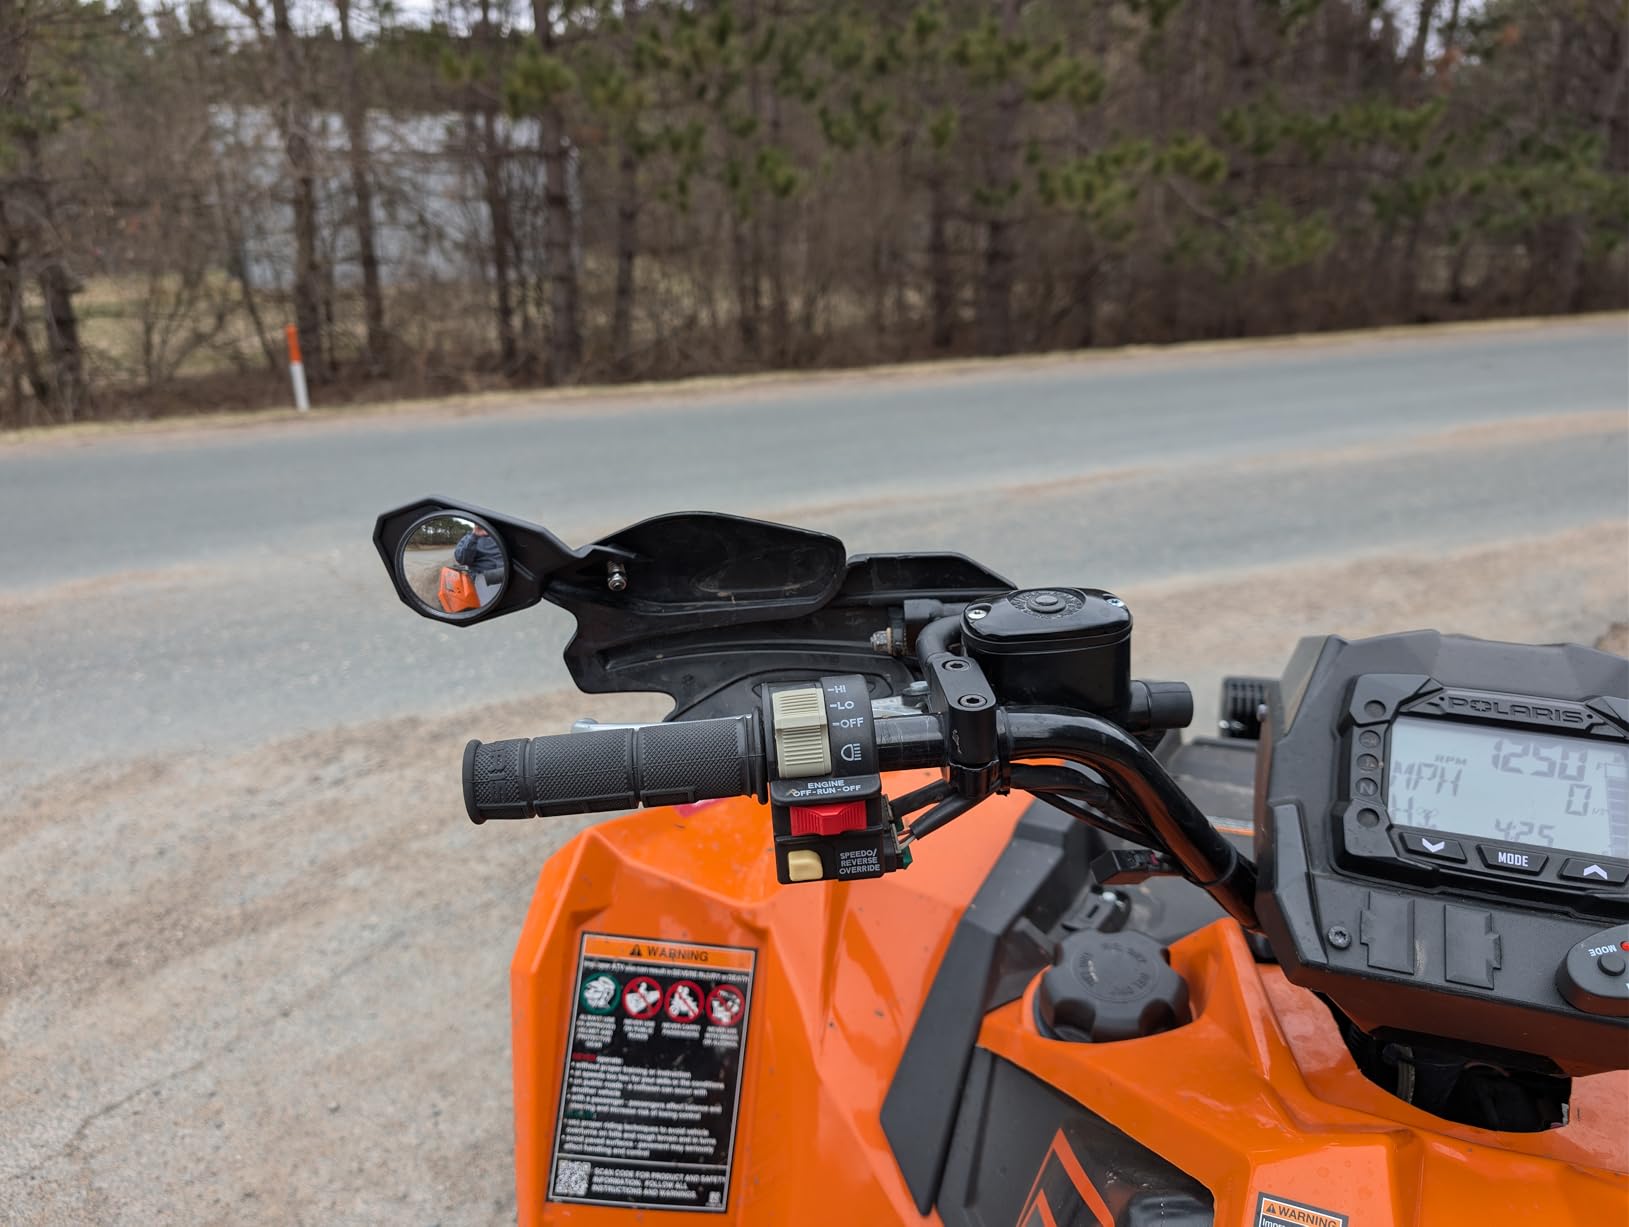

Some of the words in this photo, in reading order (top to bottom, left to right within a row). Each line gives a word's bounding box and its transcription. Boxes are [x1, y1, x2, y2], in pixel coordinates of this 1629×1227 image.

[1448, 696, 1584, 724] POLARIS
[1491, 739, 1588, 781] 1250
[808, 780, 844, 789] ENGINE
[840, 848, 877, 859] SPEEDO/
[1498, 851, 1529, 867] MODE
[839, 864, 880, 874] OVERRIDE
[841, 857, 878, 867] REVERSE
[647, 945, 709, 962] WARNING
[1588, 944, 1617, 957] MODE
[1278, 1205, 1337, 1227] WARNING
